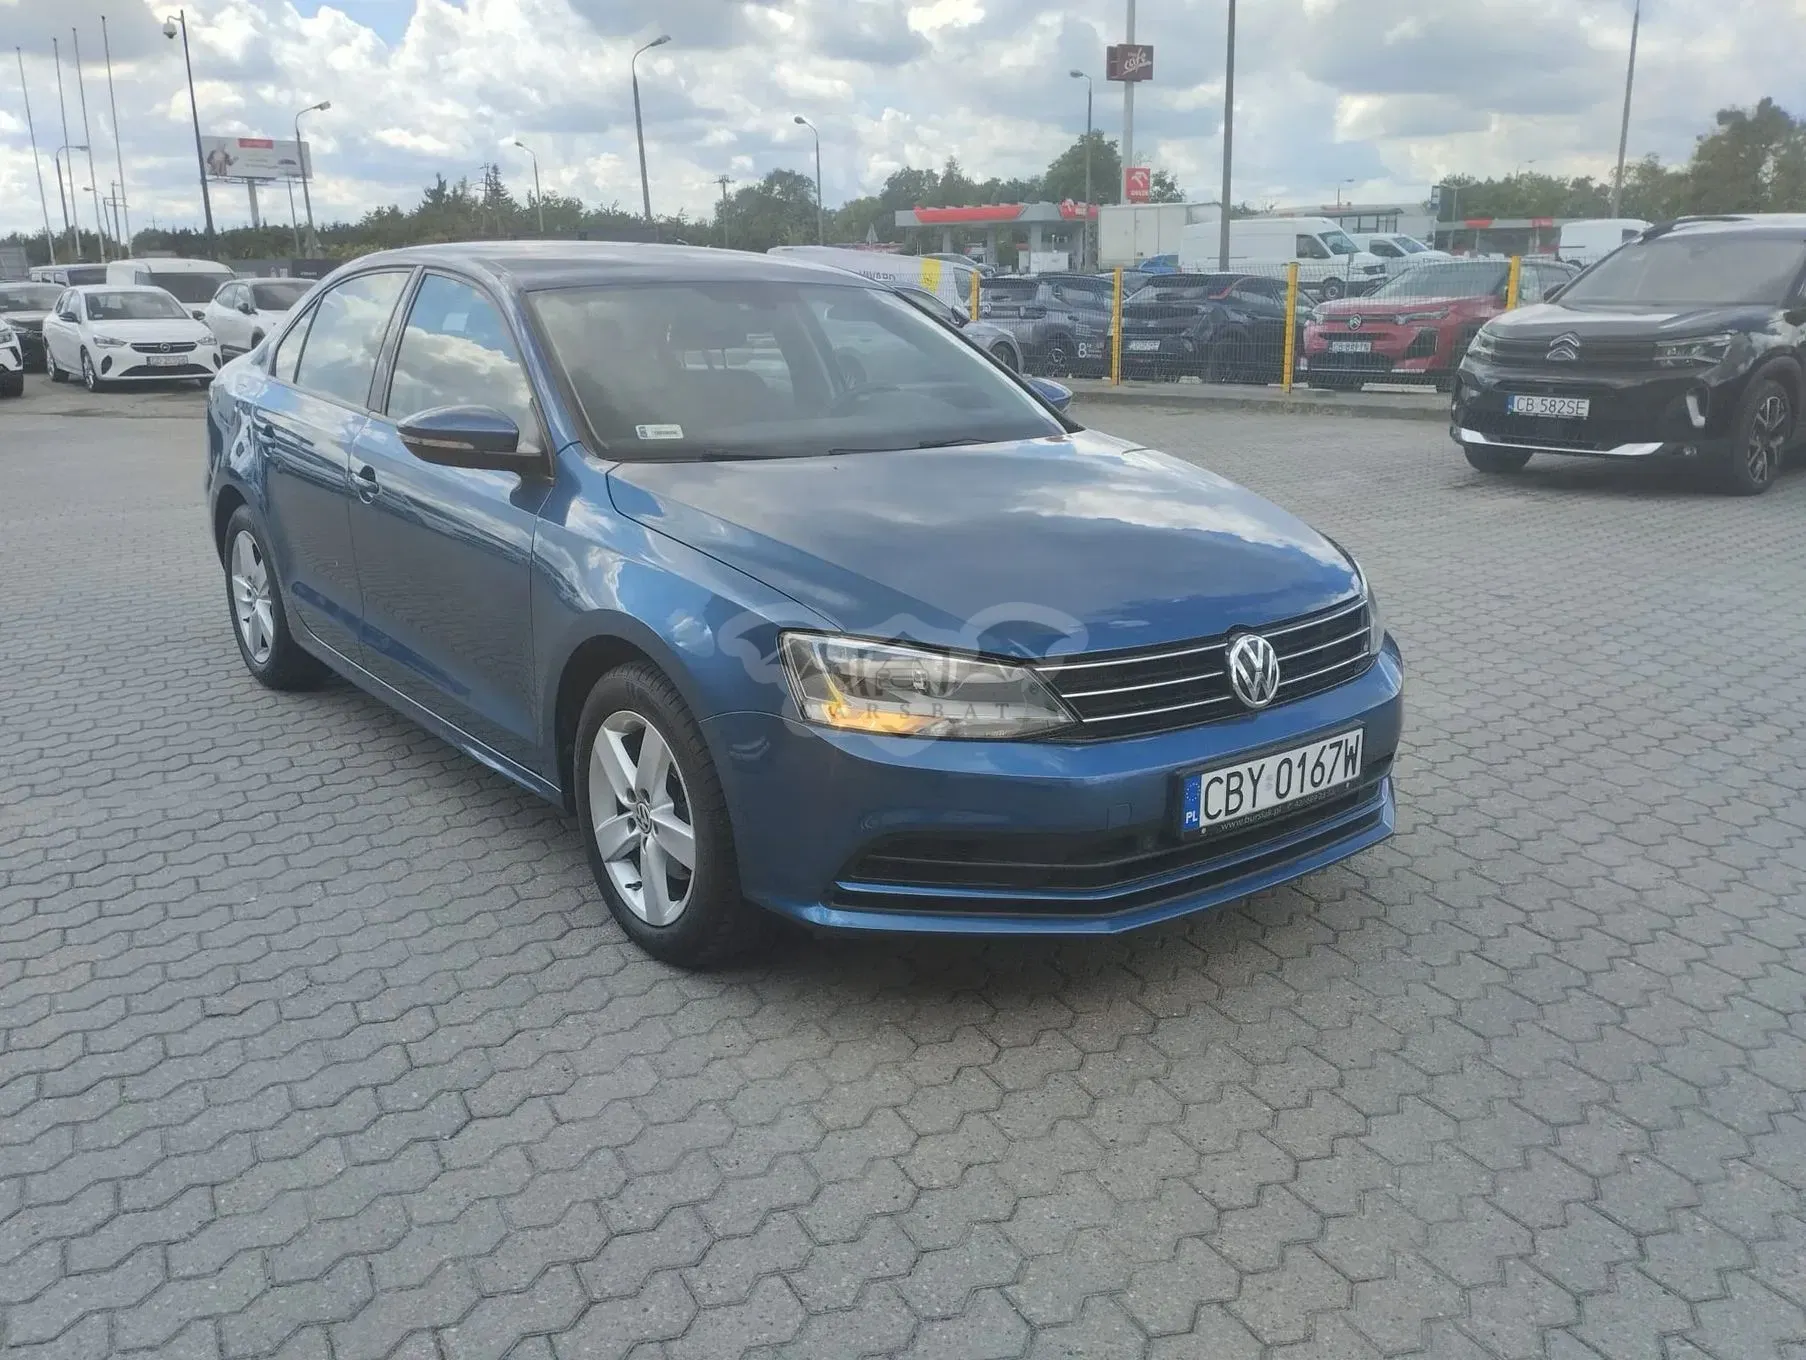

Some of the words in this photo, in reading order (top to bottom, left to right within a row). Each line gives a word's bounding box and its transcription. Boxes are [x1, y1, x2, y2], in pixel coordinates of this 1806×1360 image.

[1516, 397, 1535, 412] CB
[1539, 399, 1586, 416] 582SE
[1204, 763, 1265, 820] CBY
[1275, 735, 1360, 800] 0167W
[1185, 810, 1199, 824] PL
